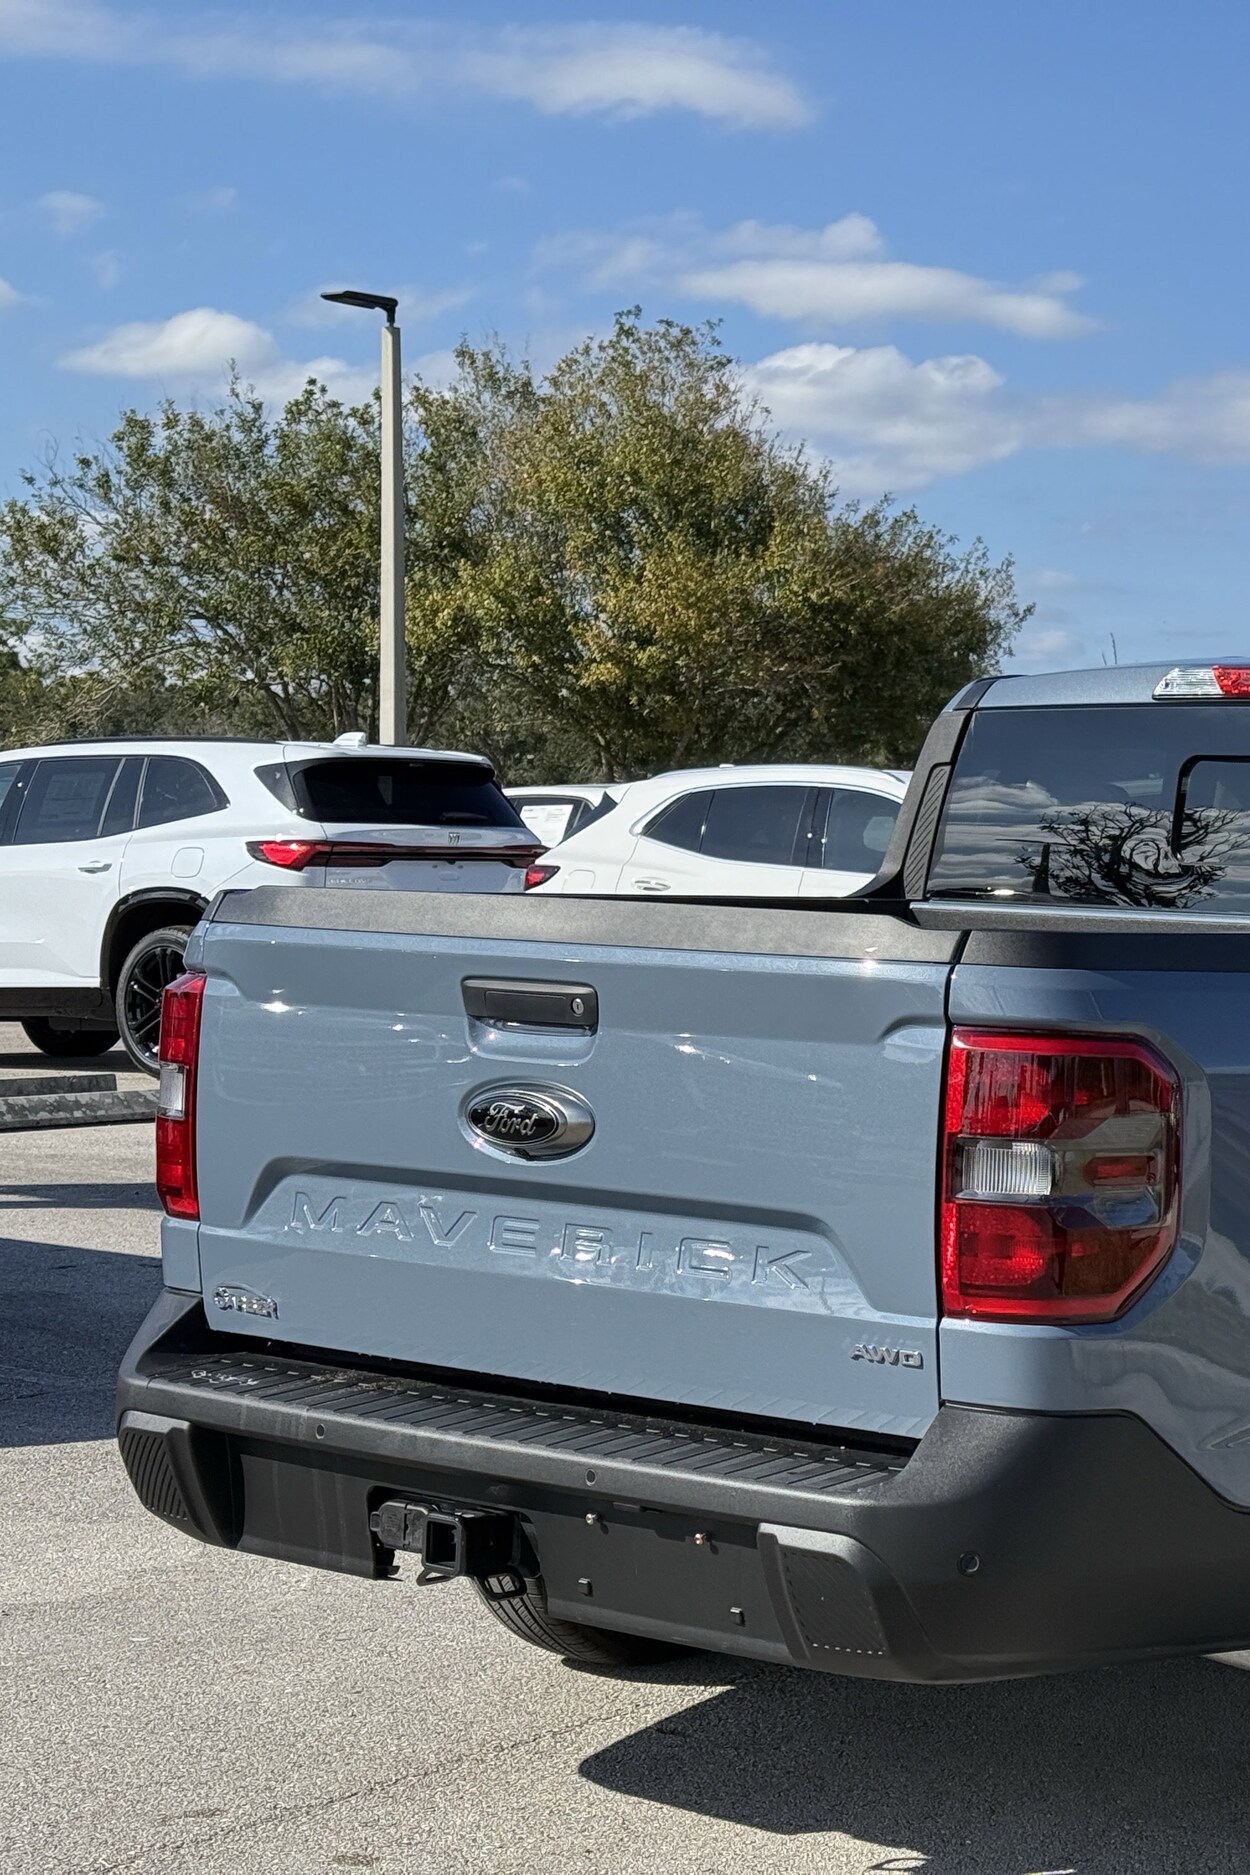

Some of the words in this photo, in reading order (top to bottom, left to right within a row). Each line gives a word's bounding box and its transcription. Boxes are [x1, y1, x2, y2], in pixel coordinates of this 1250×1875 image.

[480, 1102, 538, 1136] Ford
[289, 1191, 812, 1291] MAVERICK
[848, 1343, 923, 1370] AWD
